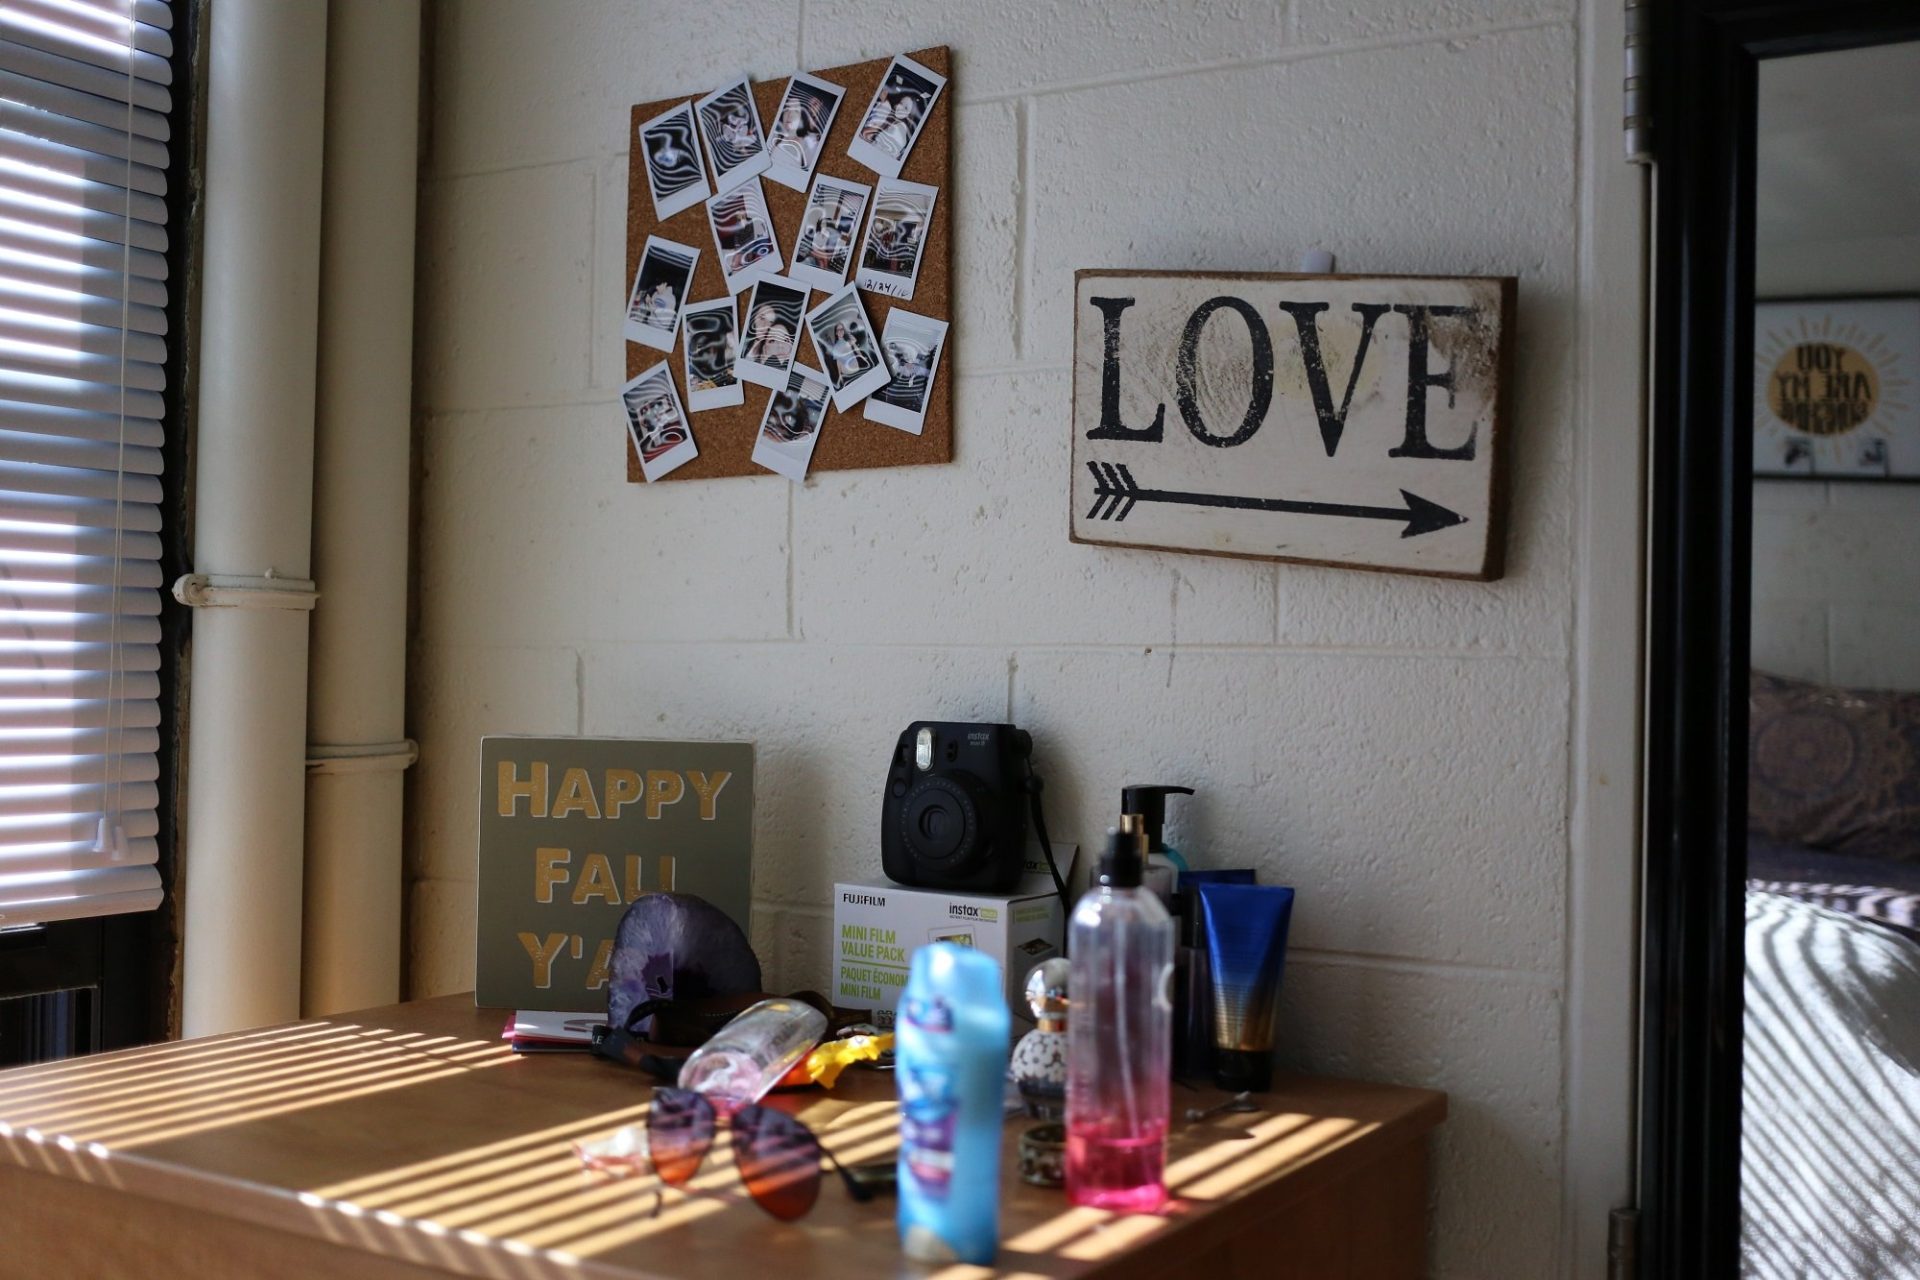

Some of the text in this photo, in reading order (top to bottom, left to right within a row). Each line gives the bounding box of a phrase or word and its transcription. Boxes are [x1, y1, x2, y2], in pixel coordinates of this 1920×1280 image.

[1086, 296, 1478, 460] LOVE
[497, 761, 732, 820] HAPPY
[843, 893, 886, 907] FUJIFILM
[949, 902, 979, 917] instax
[842, 924, 896, 945] MINI FILM
[842, 941, 905, 962] VALUE PACK
[841, 966, 871, 982] PAQUET
[841, 982, 881, 999] MINI FILM
